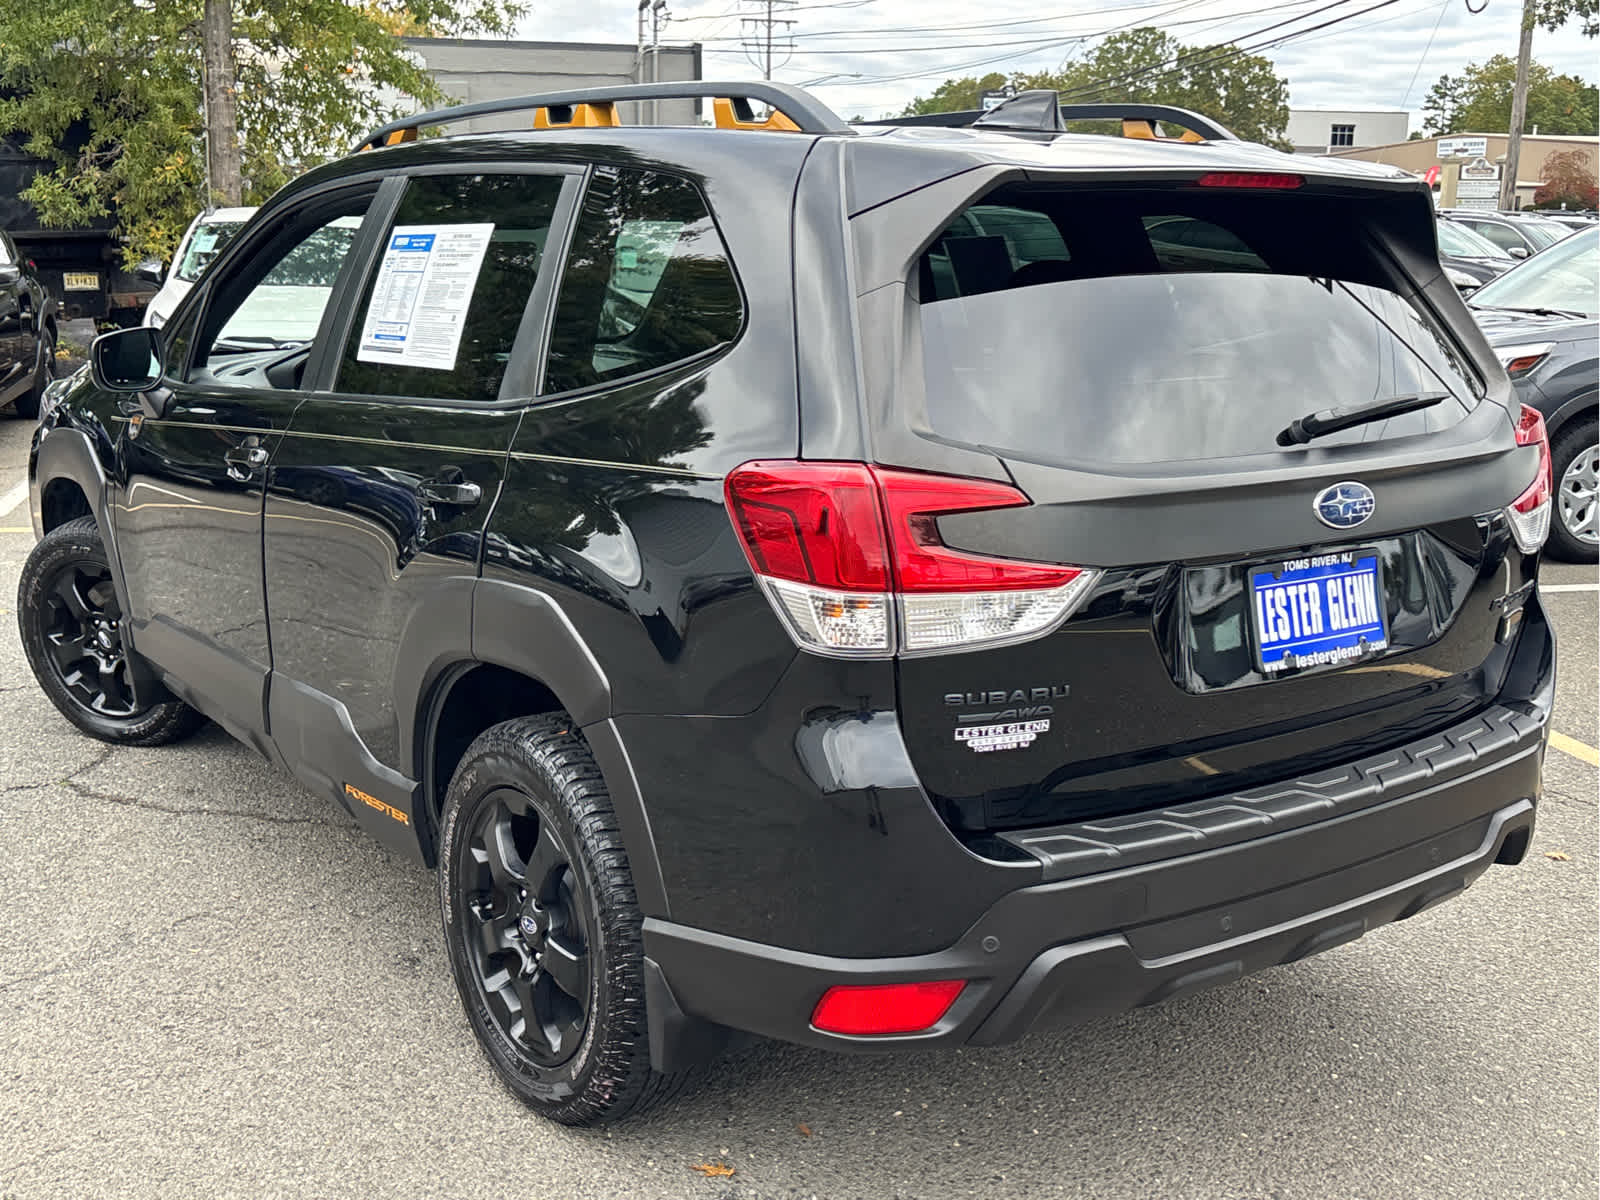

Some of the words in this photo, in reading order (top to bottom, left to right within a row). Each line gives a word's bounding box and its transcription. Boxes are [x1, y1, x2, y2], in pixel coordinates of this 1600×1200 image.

[1283, 559, 1310, 573] TOMS
[1341, 551, 1353, 563] NJ
[1255, 582, 1324, 644] LESTER
[1326, 573, 1379, 631] GLENN
[944, 684, 1071, 706] SUBARU
[994, 705, 1055, 721] AWD
[955, 726, 1004, 738] LESTER
[1007, 720, 1049, 733] GLENN
[973, 744, 994, 753] TOMS
[345, 783, 410, 826] FORESTER
